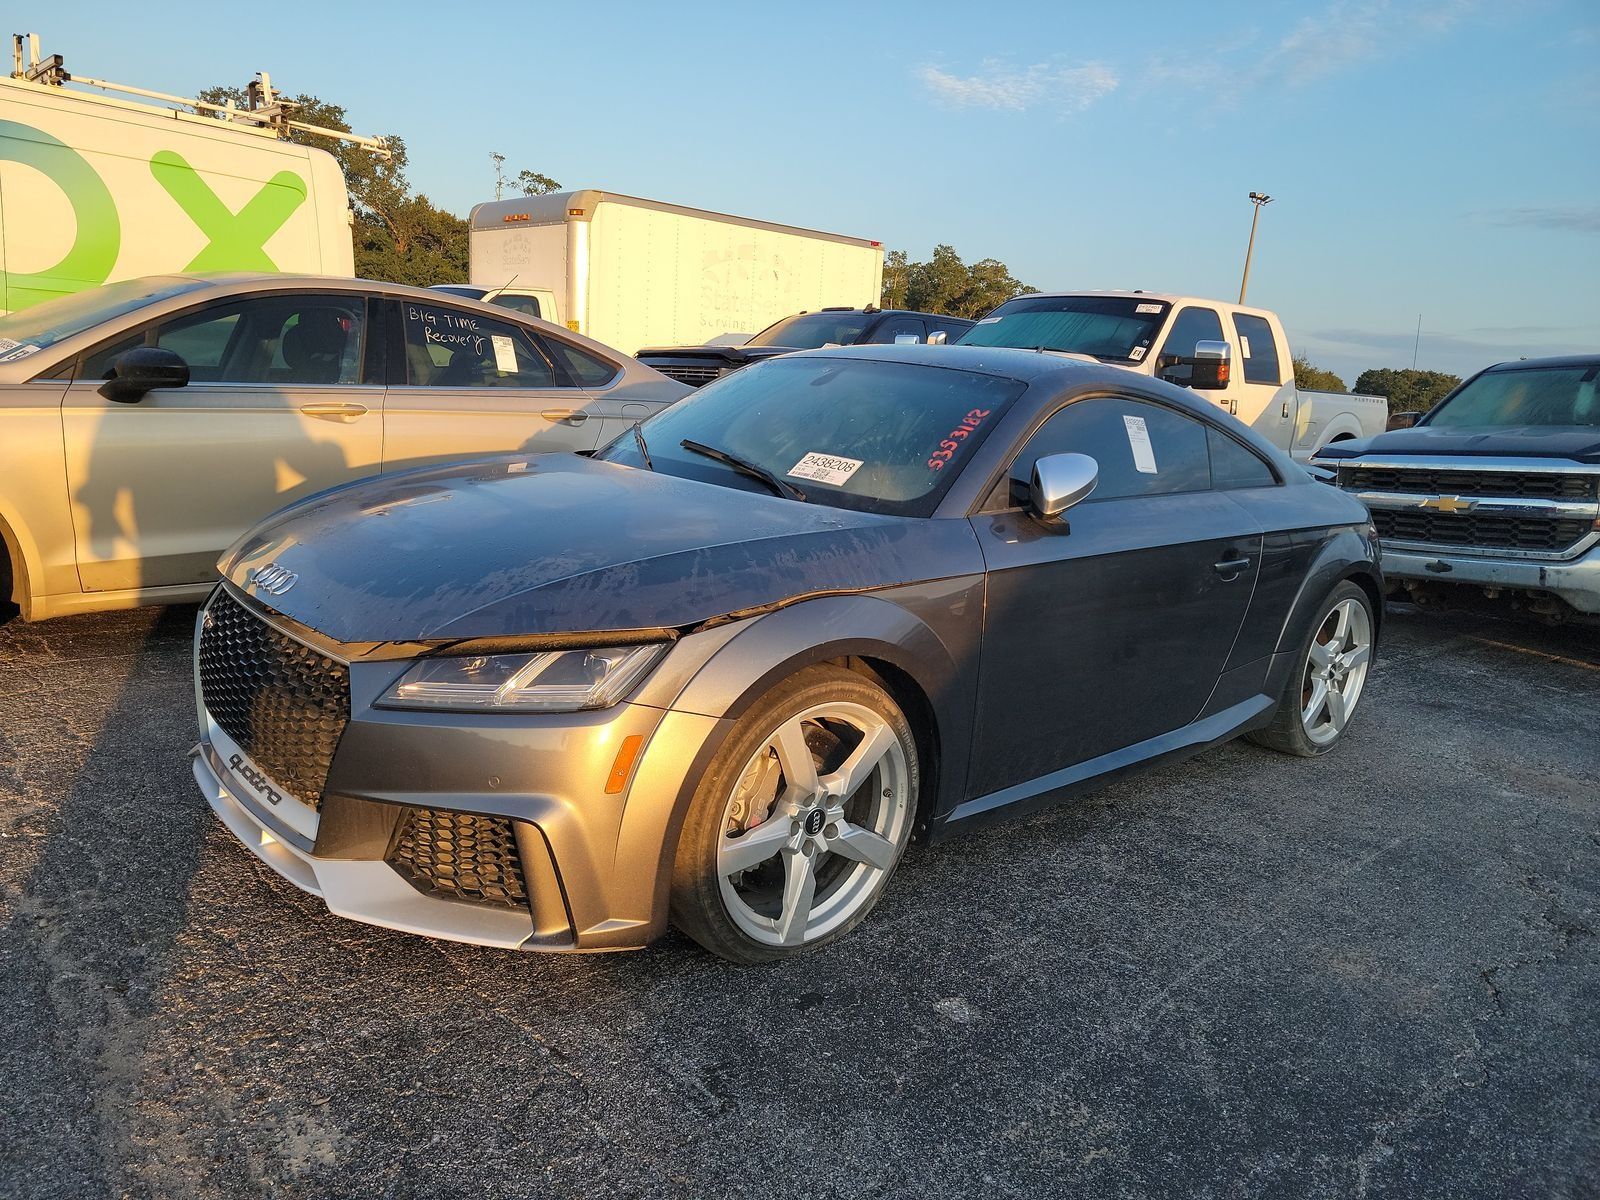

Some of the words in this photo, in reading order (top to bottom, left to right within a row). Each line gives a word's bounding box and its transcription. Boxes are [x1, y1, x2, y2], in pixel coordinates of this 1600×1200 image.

[409, 307, 436, 325] BIG
[444, 314, 480, 331] TIME
[700, 316, 747, 331] Serving
[425, 326, 487, 356] Recovery
[803, 455, 855, 473] 2438208
[228, 753, 282, 806] quattro
